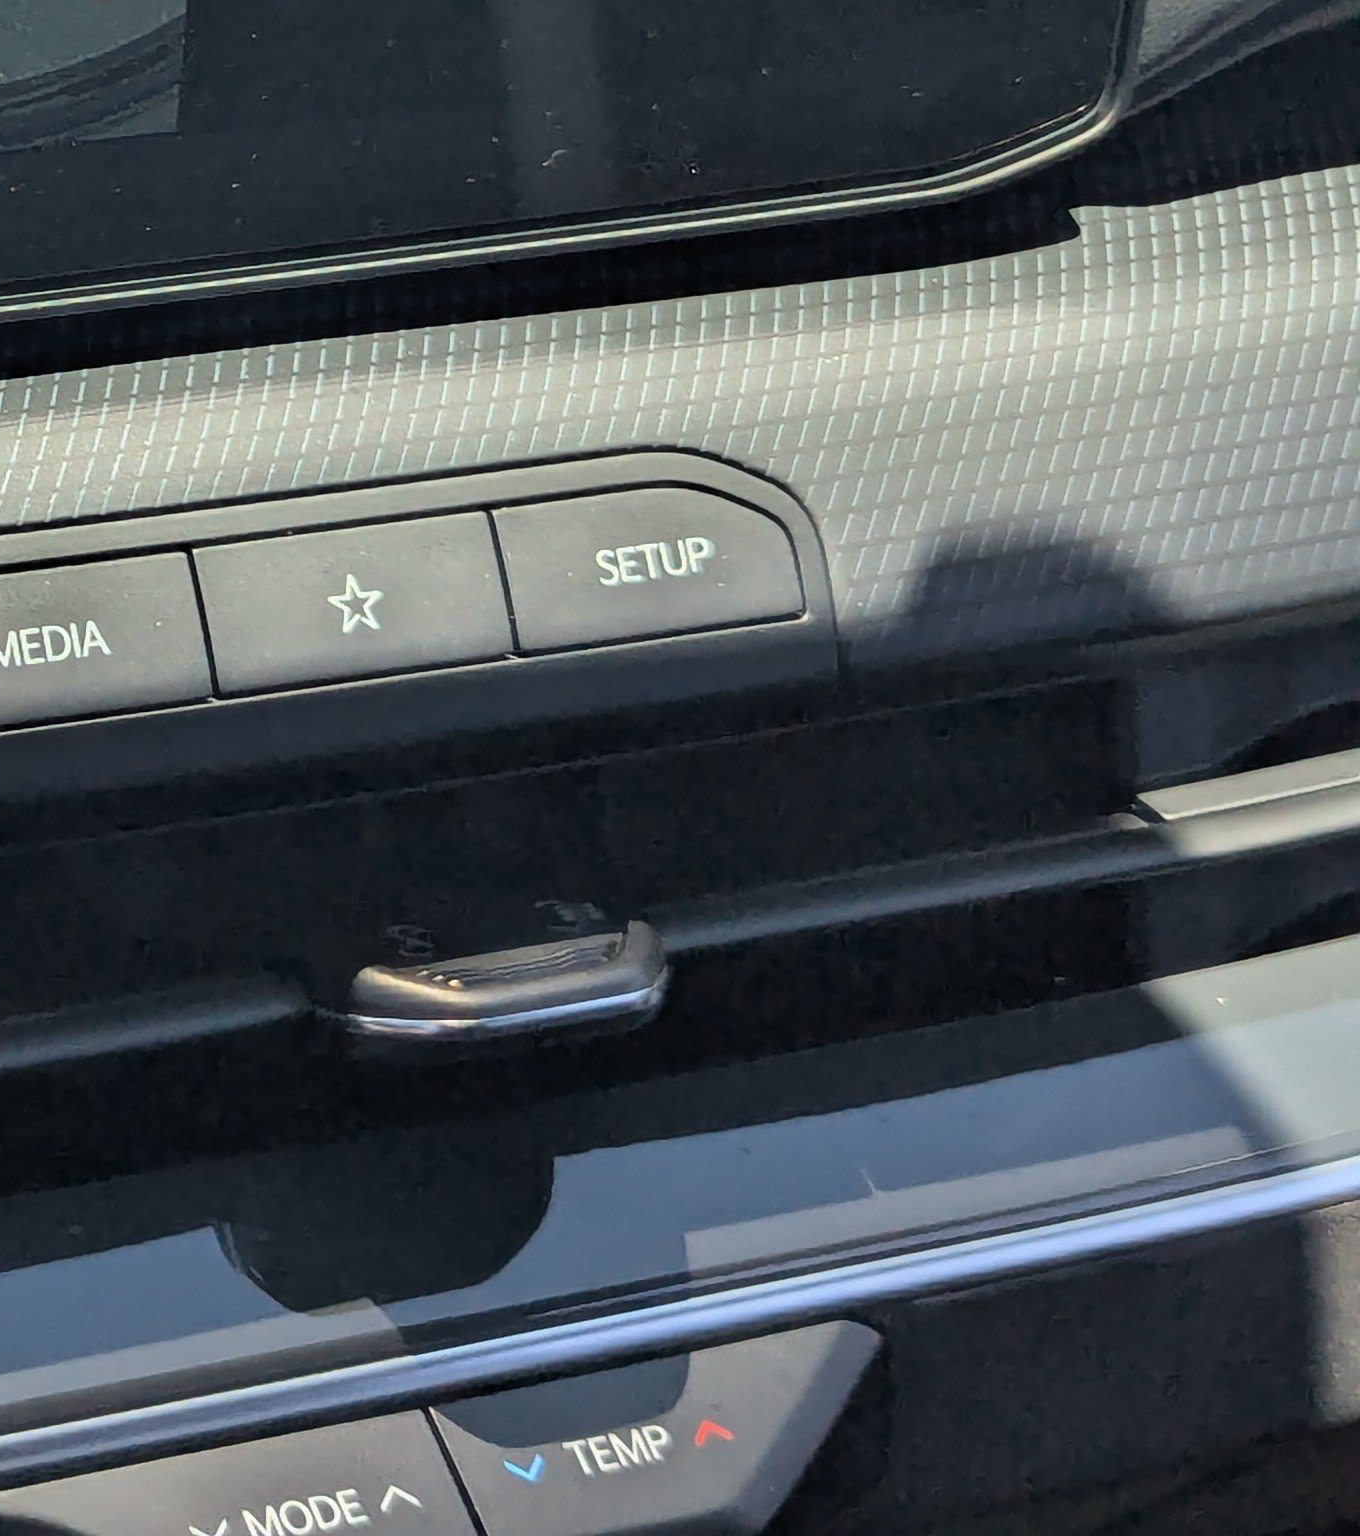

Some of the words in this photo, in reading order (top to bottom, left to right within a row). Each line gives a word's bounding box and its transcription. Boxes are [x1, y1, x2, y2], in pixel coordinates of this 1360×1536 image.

[595, 536, 716, 589] SETUP
[560, 1424, 672, 1478] TEMP
[241, 1486, 371, 1536] MODE
